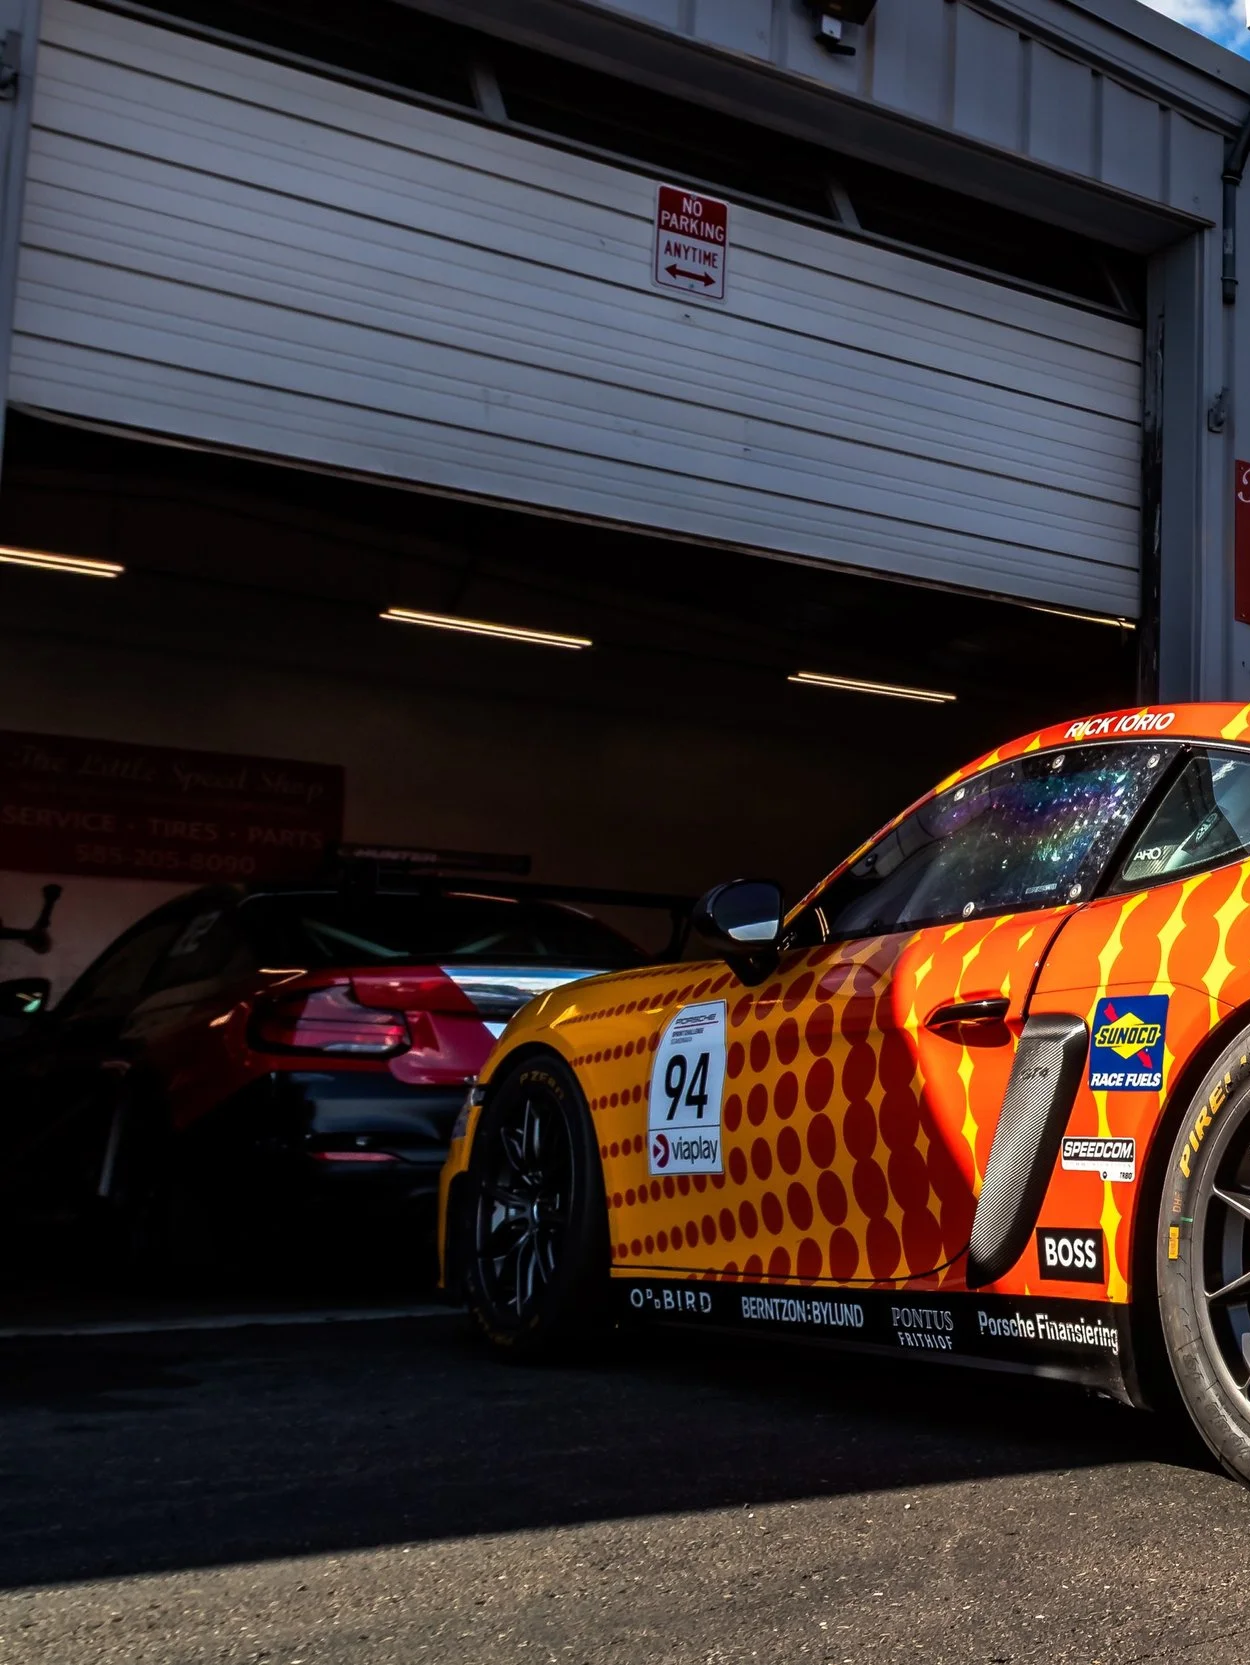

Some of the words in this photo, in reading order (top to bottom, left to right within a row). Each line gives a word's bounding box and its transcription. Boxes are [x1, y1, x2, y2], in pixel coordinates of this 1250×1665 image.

[682, 197, 703, 217] NO
[660, 210, 725, 242] PARKING
[664, 239, 719, 269] ANYTIME
[1063, 718, 1112, 739] RICK
[1113, 711, 1176, 733] IORIO
[8, 744, 67, 773] The
[78, 752, 156, 783] Little
[170, 762, 249, 796] Speed
[256, 771, 325, 804] Shop
[2, 804, 117, 834] SERVICE
[148, 816, 220, 842] TIRES
[247, 825, 324, 851] PARTS
[74, 842, 257, 874] 585-205-8090
[1096, 1025, 1159, 1046] SUNOCO
[664, 1052, 710, 1121] 94
[1090, 1072, 1123, 1088] RACE
[1124, 1071, 1162, 1088] FUELS
[671, 1135, 718, 1165] viaplay
[1044, 1237, 1097, 1269] BOSS
[891, 1306, 954, 1331] PONTUS
[977, 1310, 1035, 1338] Porsche
[1035, 1312, 1119, 1356] Finansiering
[897, 1331, 953, 1350] FRITHIOF
